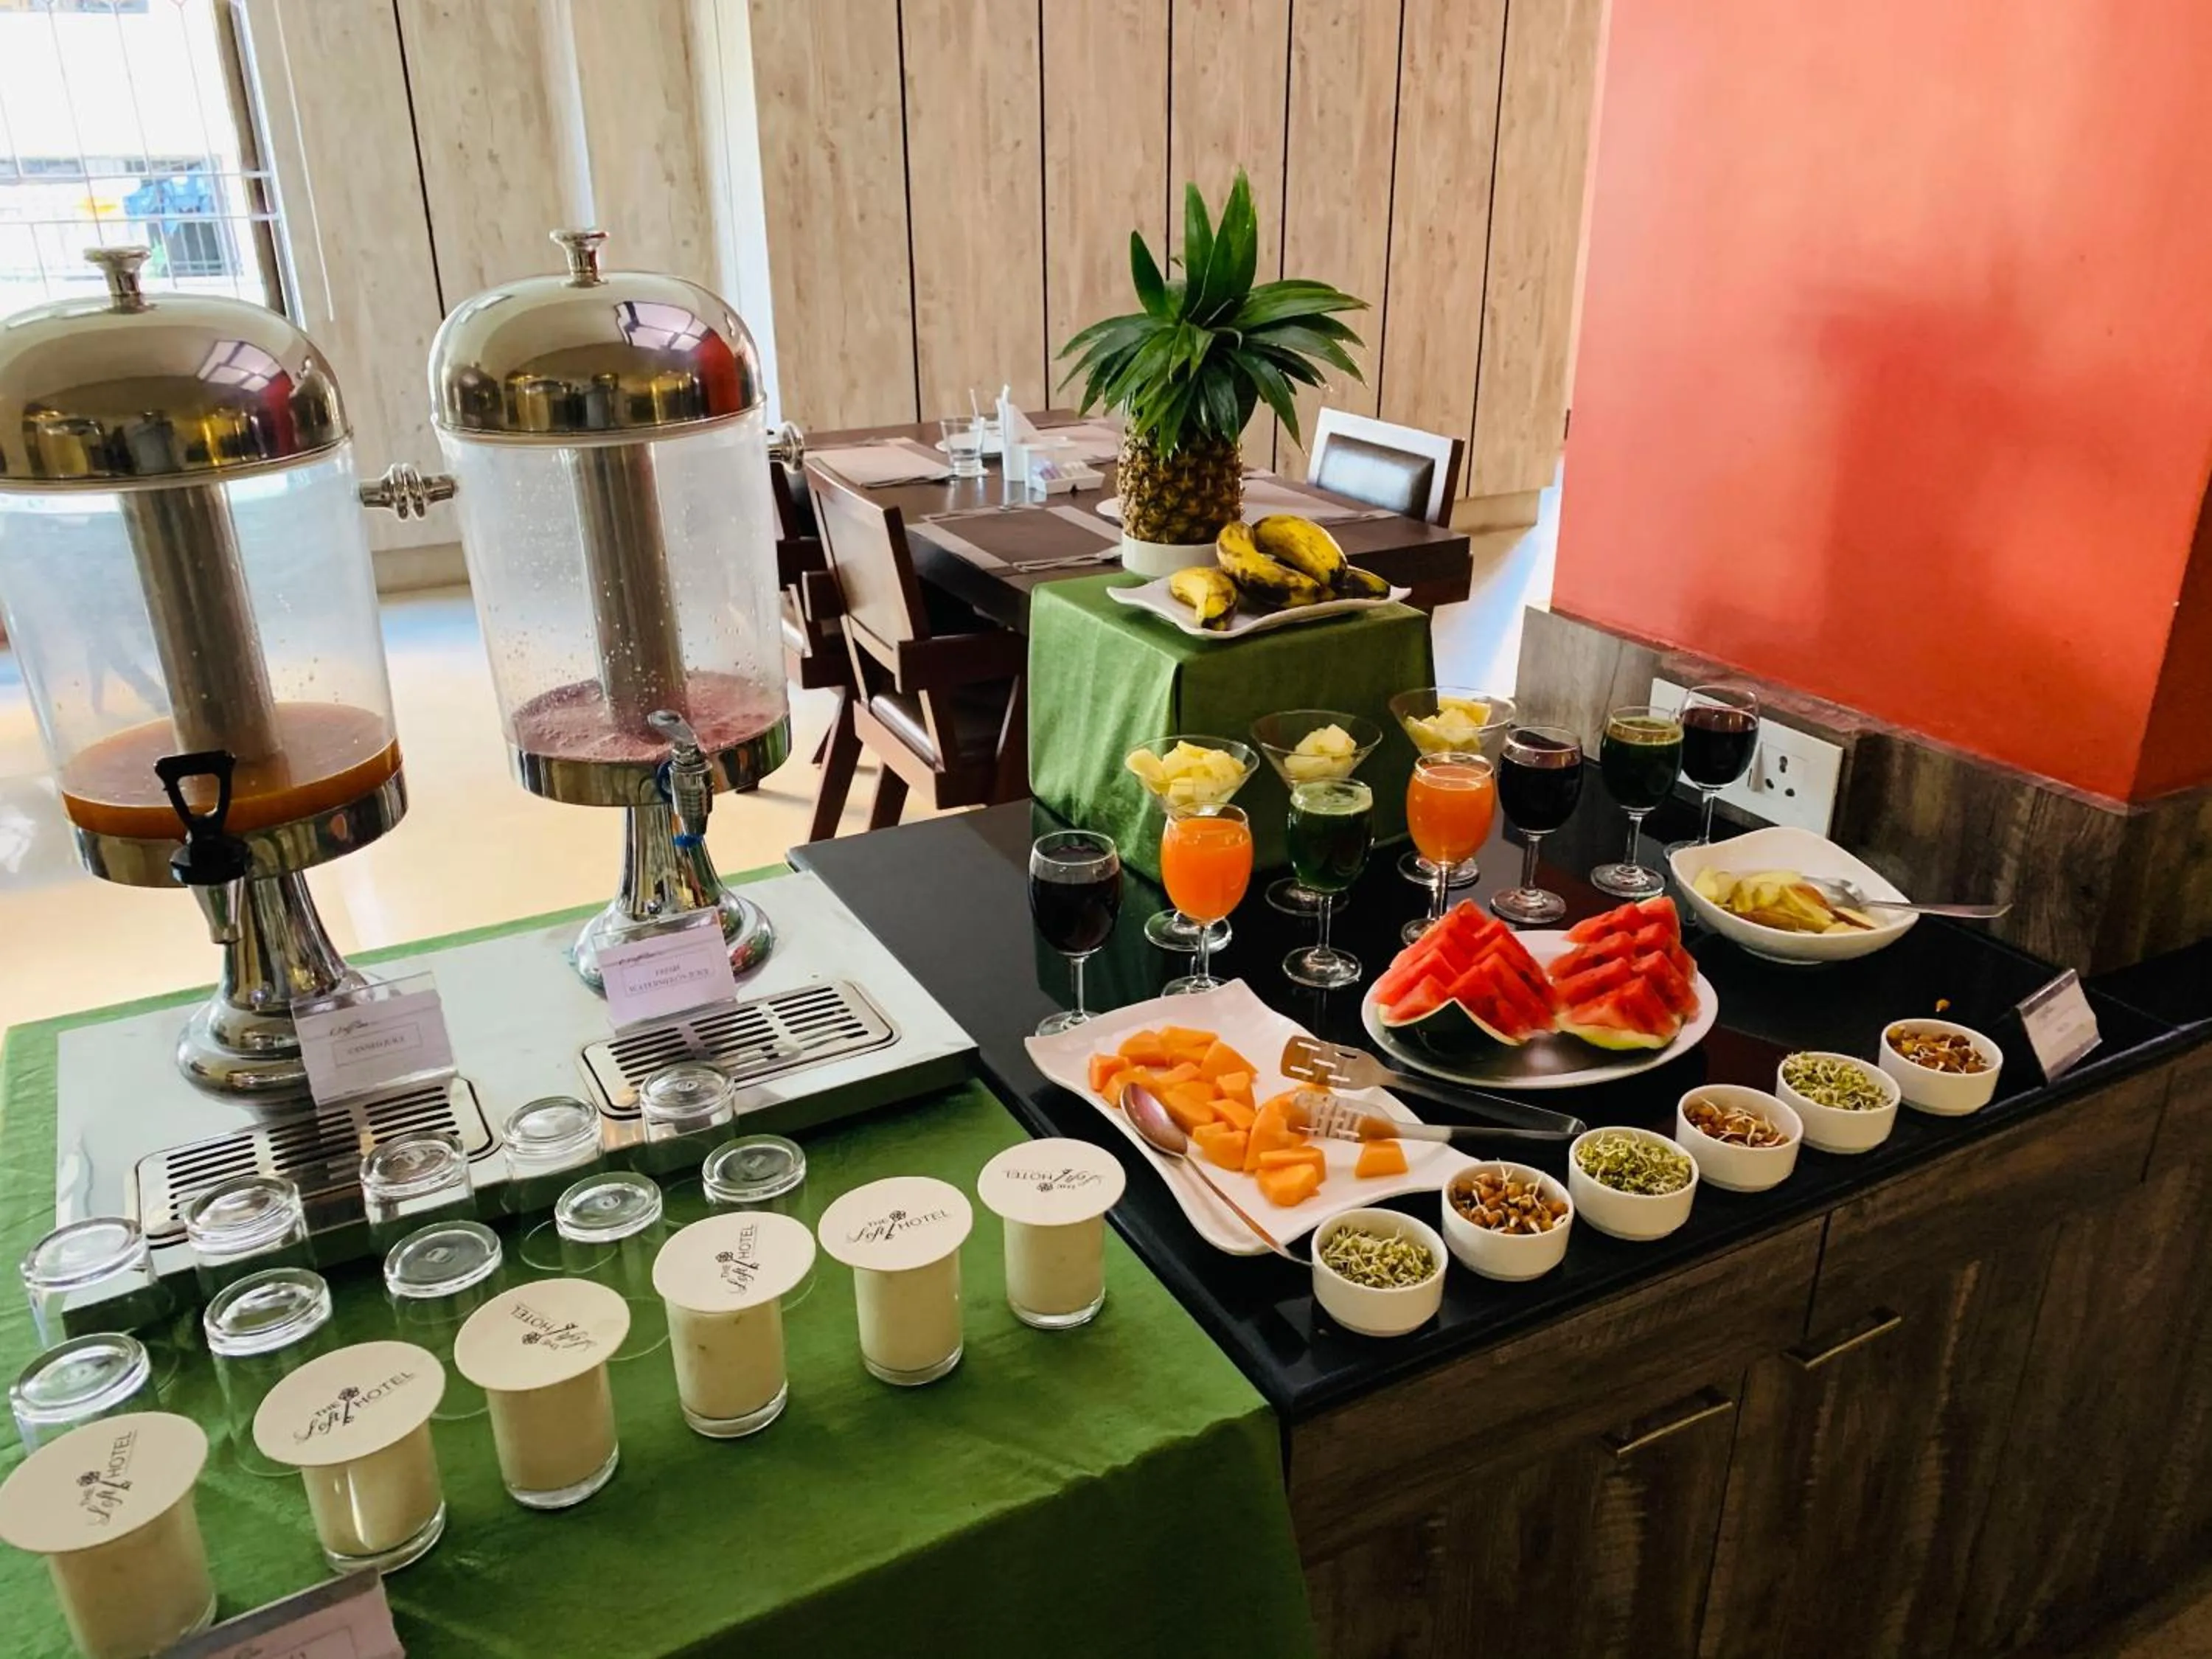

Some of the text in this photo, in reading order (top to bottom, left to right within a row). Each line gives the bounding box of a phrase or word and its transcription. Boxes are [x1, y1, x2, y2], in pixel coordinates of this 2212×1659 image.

[1004, 1169, 1053, 1180] HOTEL
[897, 1208, 949, 1231] HOTEL
[737, 1223, 755, 1259] HOTEL
[510, 1305, 554, 1332] HOTEL
[352, 1370, 415, 1409] HOTEL
[315, 1402, 341, 1417] THE
[105, 1430, 133, 1478] HOTEL
